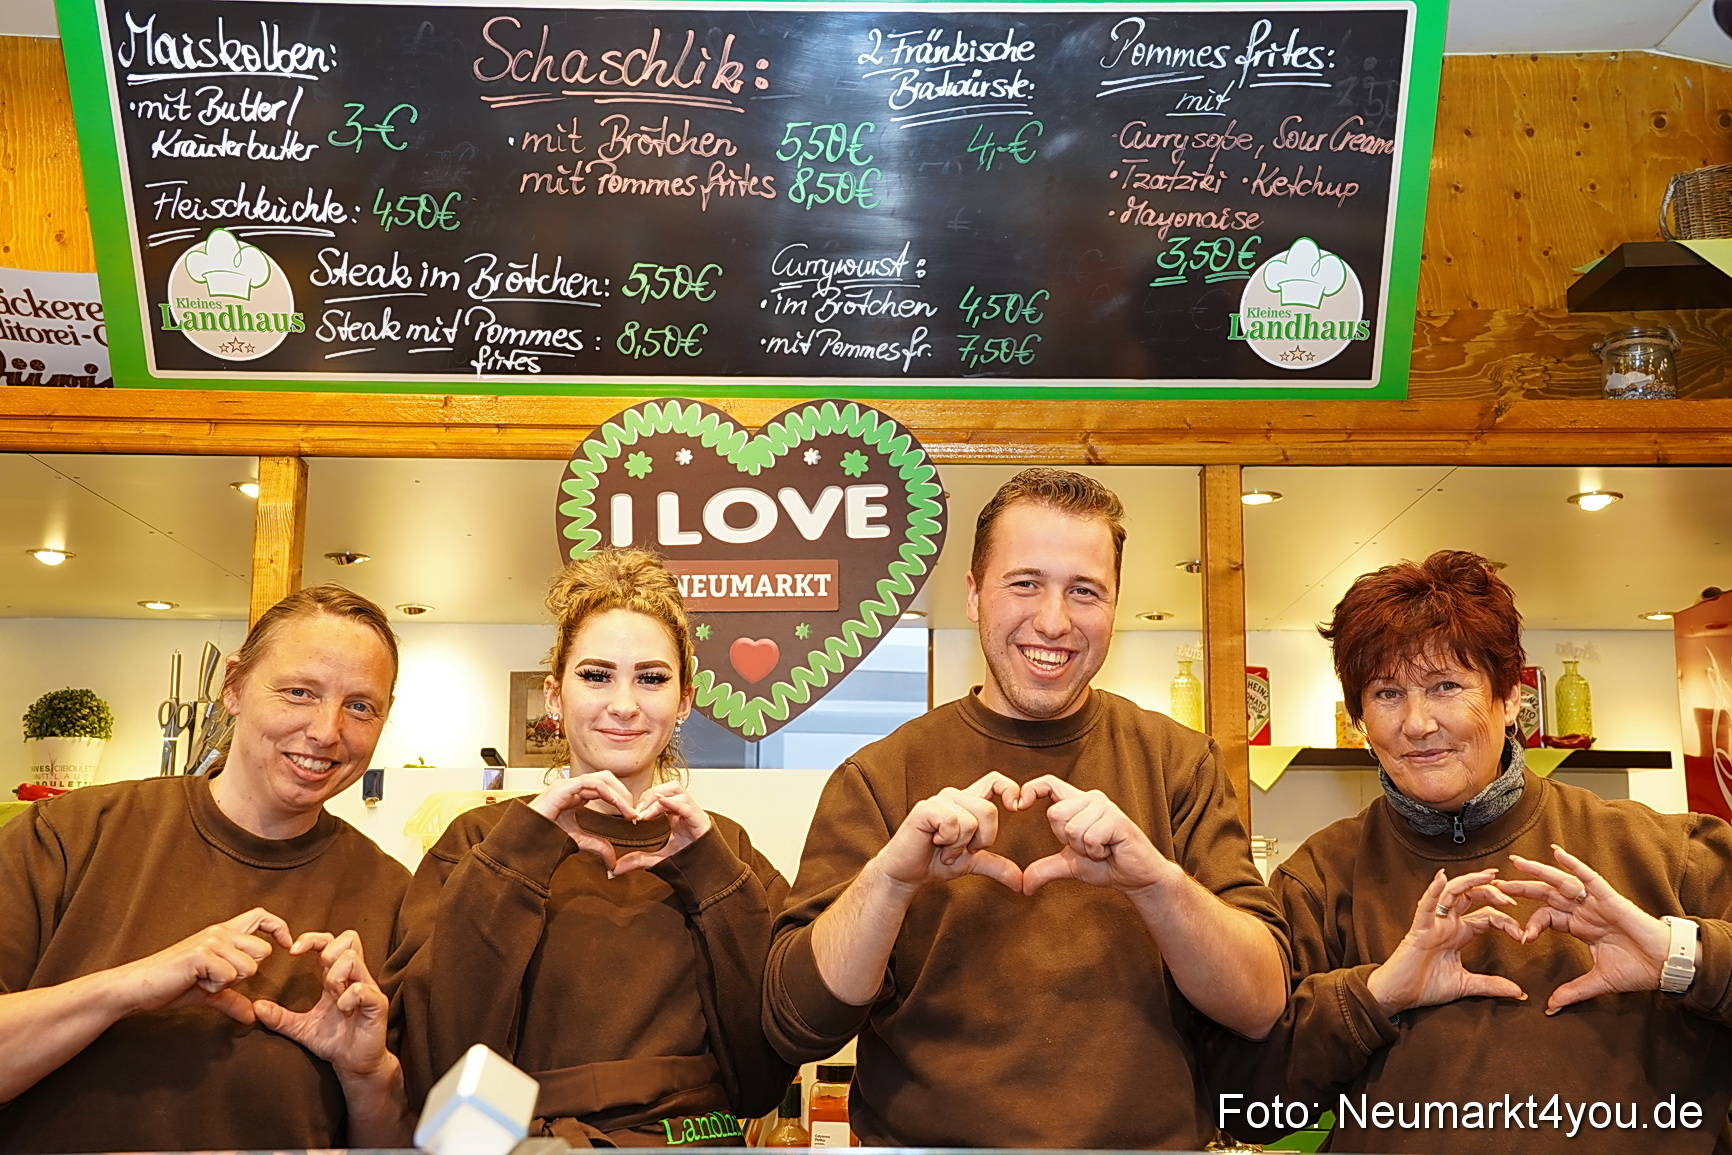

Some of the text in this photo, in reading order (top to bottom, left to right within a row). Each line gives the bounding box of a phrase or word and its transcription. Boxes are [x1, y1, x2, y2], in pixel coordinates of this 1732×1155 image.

[118, 11, 338, 73] Maiskolben:
[473, 16, 769, 93] Schaschlik:
[858, 28, 1035, 65] 2 Fränkische
[1100, 17, 1335, 89] Pommes frites:
[138, 88, 191, 121] mit
[1175, 80, 1235, 111] mit
[151, 128, 320, 160] Kräuterbutter
[522, 117, 586, 153] mit
[598, 114, 737, 162] Brötchen
[1273, 115, 1329, 151] Sour
[520, 161, 586, 196] mit
[586, 160, 697, 197] Pommes
[701, 160, 777, 212] frites
[1122, 158, 1359, 208] Tzatziki Ketchup
[1119, 196, 1264, 241] Mayonaise
[310, 248, 412, 288] Steak
[420, 261, 460, 290] im
[158, 303, 306, 333] Landhaus
[176, 298, 222, 309] Kleines
[774, 294, 806, 315] im
[812, 286, 938, 323] Brötchen
[1247, 307, 1291, 318] Kleines
[316, 307, 401, 342] Steak
[406, 308, 462, 342] mit
[1228, 313, 1370, 342] Landhaus
[470, 345, 542, 377] frites
[766, 329, 816, 354] mit
[816, 328, 900, 361] Pommes
[611, 484, 891, 547] I LOVE
[673, 574, 832, 598] NEUMARKT
